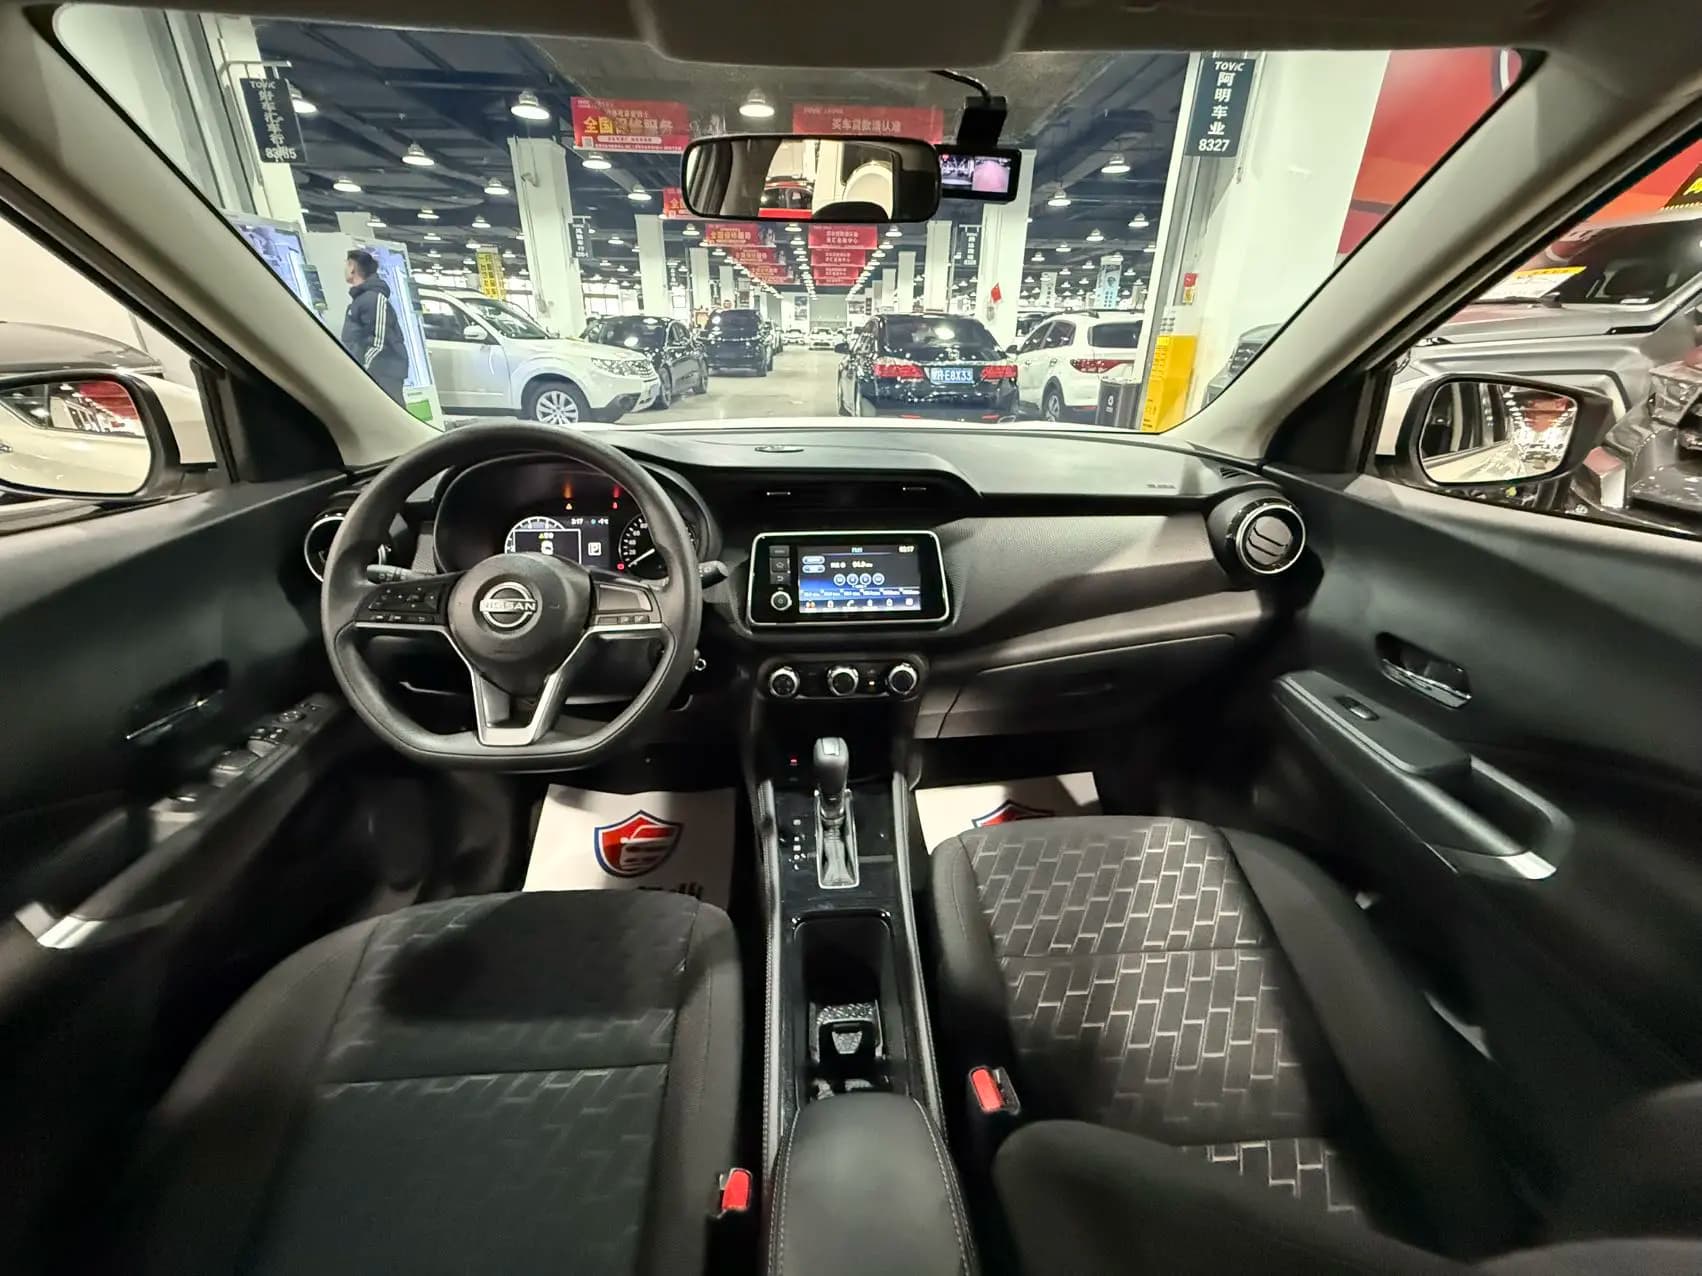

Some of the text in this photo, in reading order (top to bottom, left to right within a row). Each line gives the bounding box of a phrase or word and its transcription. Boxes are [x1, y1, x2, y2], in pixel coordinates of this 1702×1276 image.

[1207, 72, 1236, 135] 阿明车业
[1198, 139, 1231, 152] 8327
[480, 601, 536, 611] NISSAN
